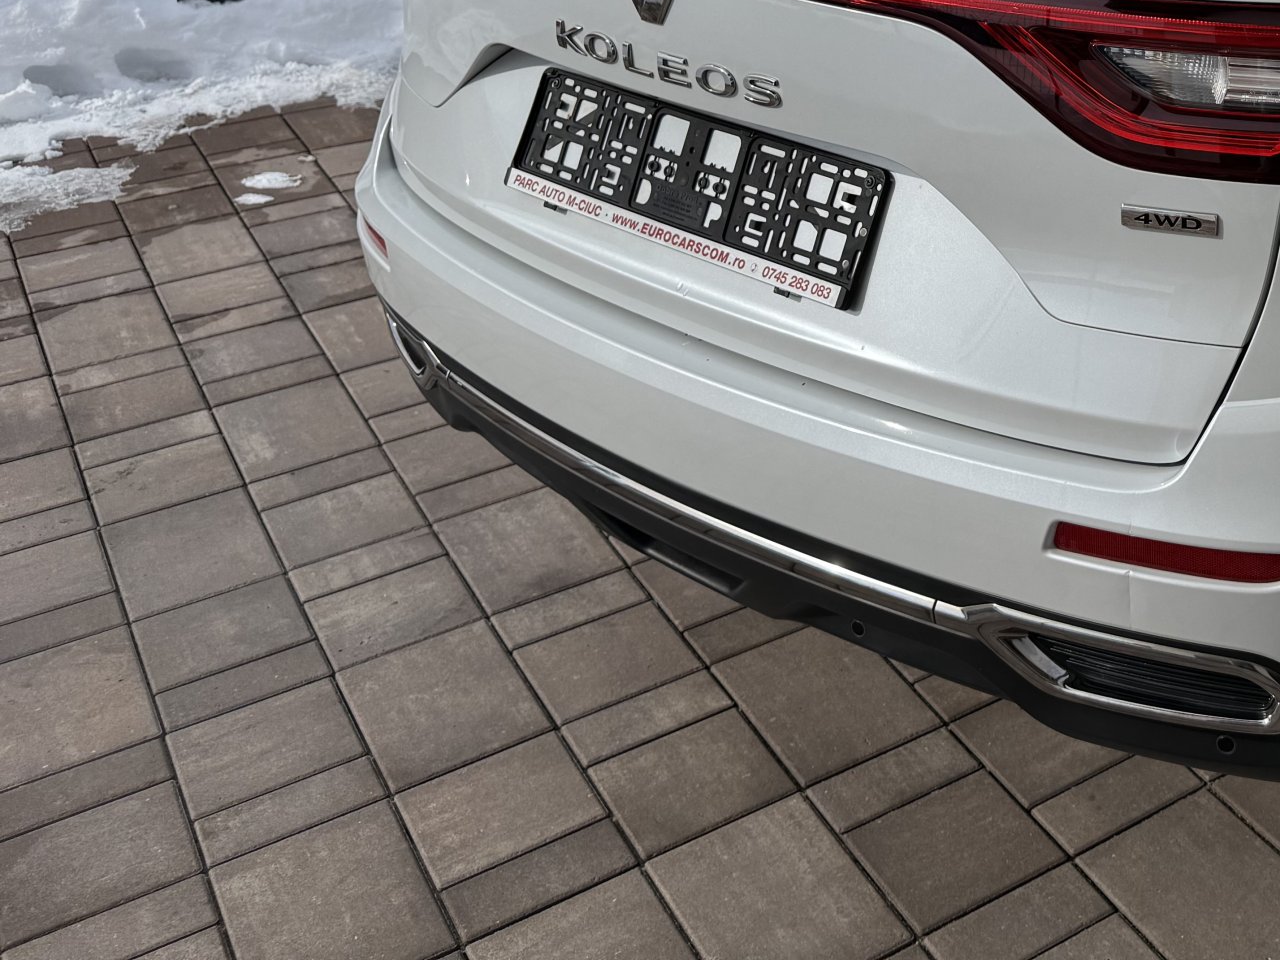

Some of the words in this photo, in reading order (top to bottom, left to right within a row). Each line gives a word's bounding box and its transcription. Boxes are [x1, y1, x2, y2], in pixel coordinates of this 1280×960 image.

[556, 18, 783, 108] KOLEOS
[513, 174, 540, 193] PARC
[539, 183, 566, 203] AUTO
[565, 194, 603, 217] M-CIUC
[611, 212, 746, 270] www.EUROCARSCOM.ro
[762, 265, 788, 284] 0745
[788, 275, 810, 292] 283
[810, 282, 832, 300] 083
[1133, 212, 1203, 230] 4WD
